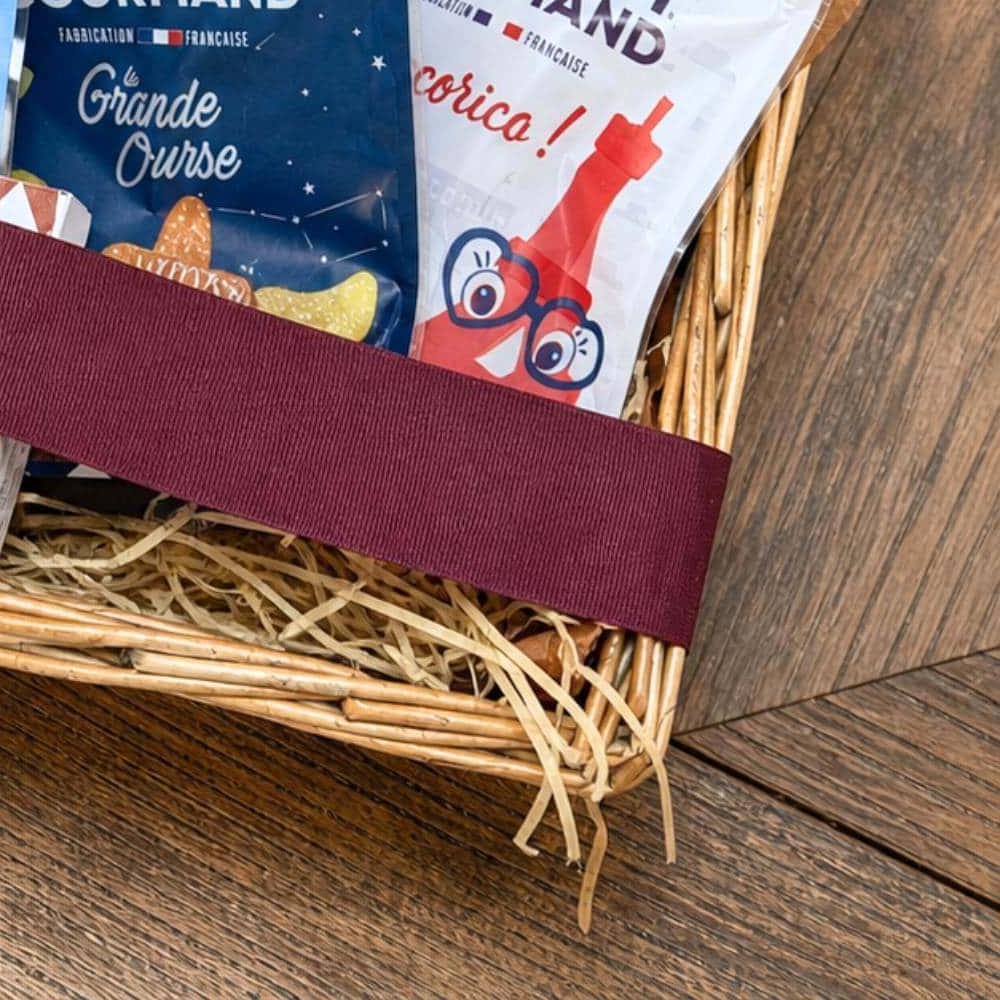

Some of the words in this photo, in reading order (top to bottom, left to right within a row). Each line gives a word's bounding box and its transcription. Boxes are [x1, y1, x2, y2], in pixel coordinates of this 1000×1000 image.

[77, 61, 223, 129] Grande
[115, 130, 243, 189] Ourse
[535, 104, 588, 159] !
